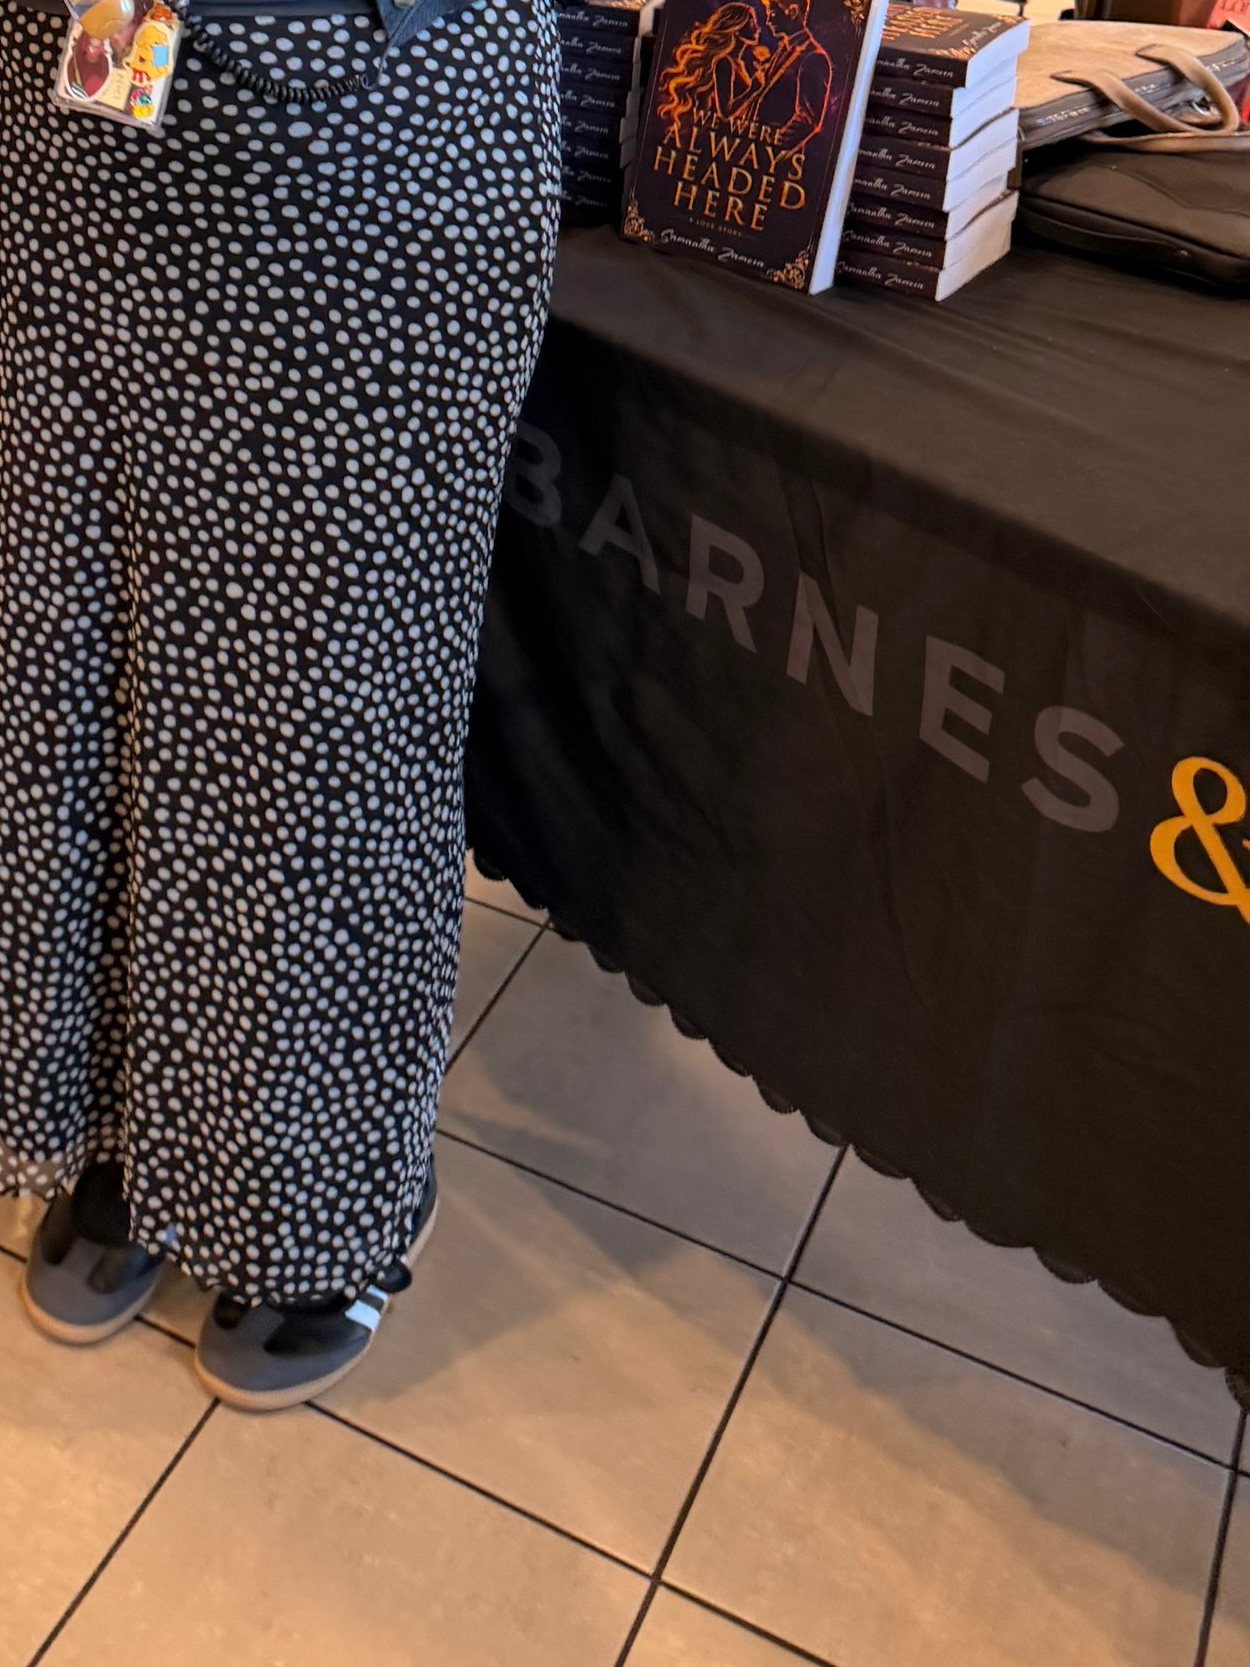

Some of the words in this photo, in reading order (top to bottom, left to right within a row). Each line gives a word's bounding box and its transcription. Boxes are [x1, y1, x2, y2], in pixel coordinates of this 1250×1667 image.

[663, 122, 806, 181] ALWAYS
[692, 107, 720, 129] WE
[729, 116, 785, 146] WERE
[653, 146, 807, 210] HEADED
[674, 181, 769, 232] HERE
[660, 227, 715, 253] Samantha
[505, 417, 1126, 833] BARNES
[1149, 755, 1250, 925] &
